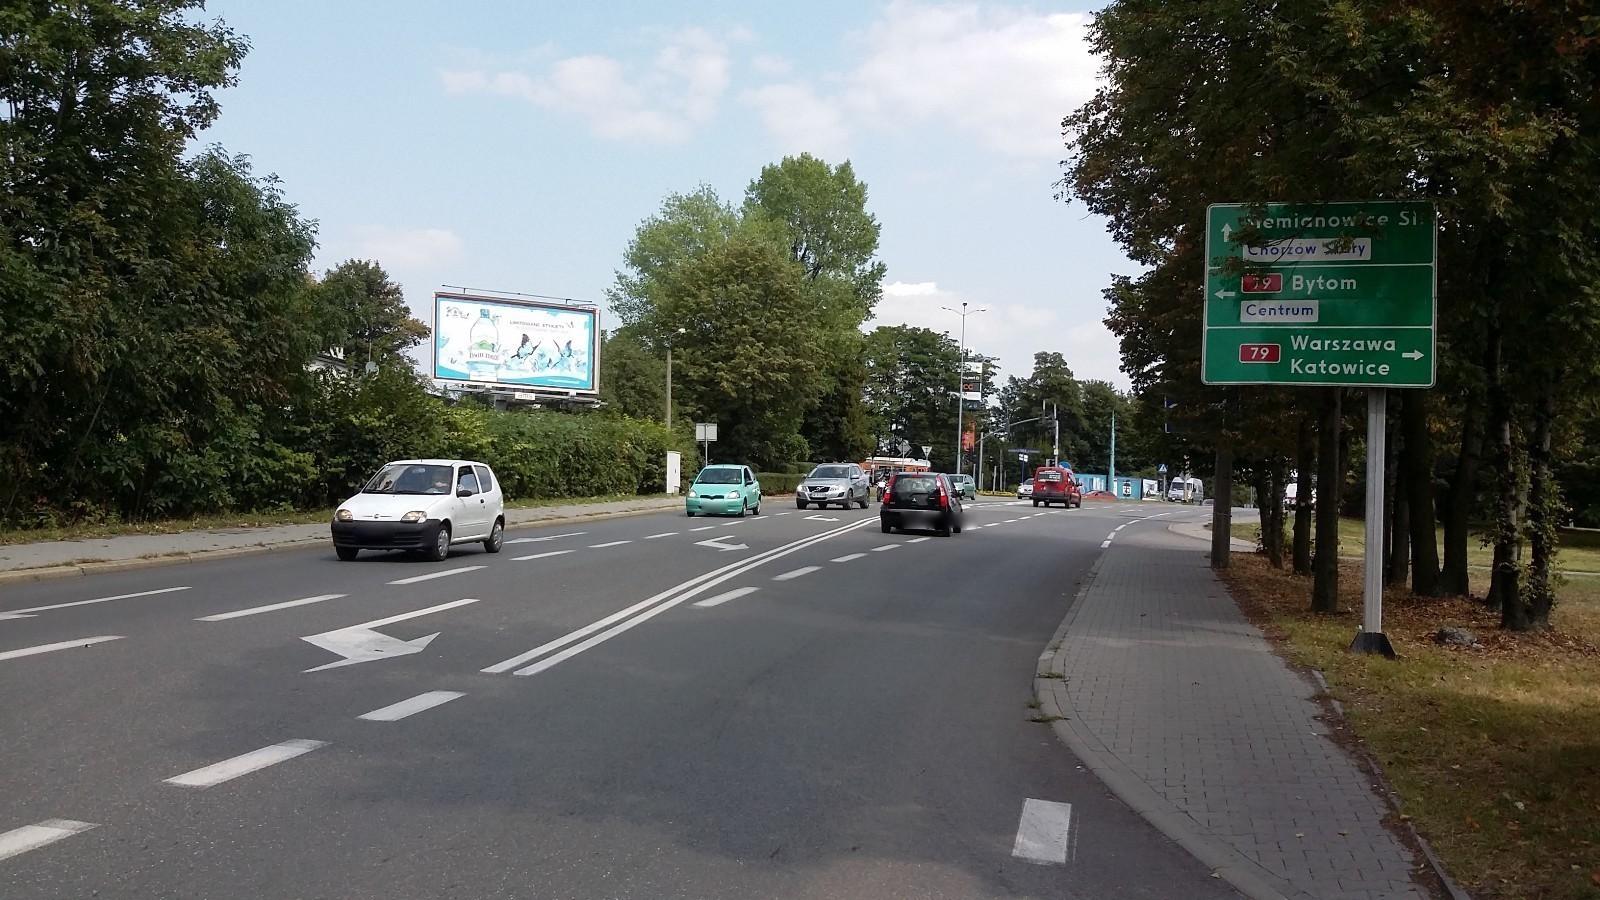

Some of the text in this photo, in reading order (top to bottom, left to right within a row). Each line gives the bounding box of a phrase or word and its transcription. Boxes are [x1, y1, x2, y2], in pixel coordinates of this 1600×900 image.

[1246, 213, 1389, 229] iemianowce
[1292, 275, 1357, 295] Bytom
[1246, 304, 1314, 316] Centrum
[1290, 335, 1396, 352] Warszawa
[1250, 347, 1270, 360] 79
[1290, 359, 1390, 376] Katowice
